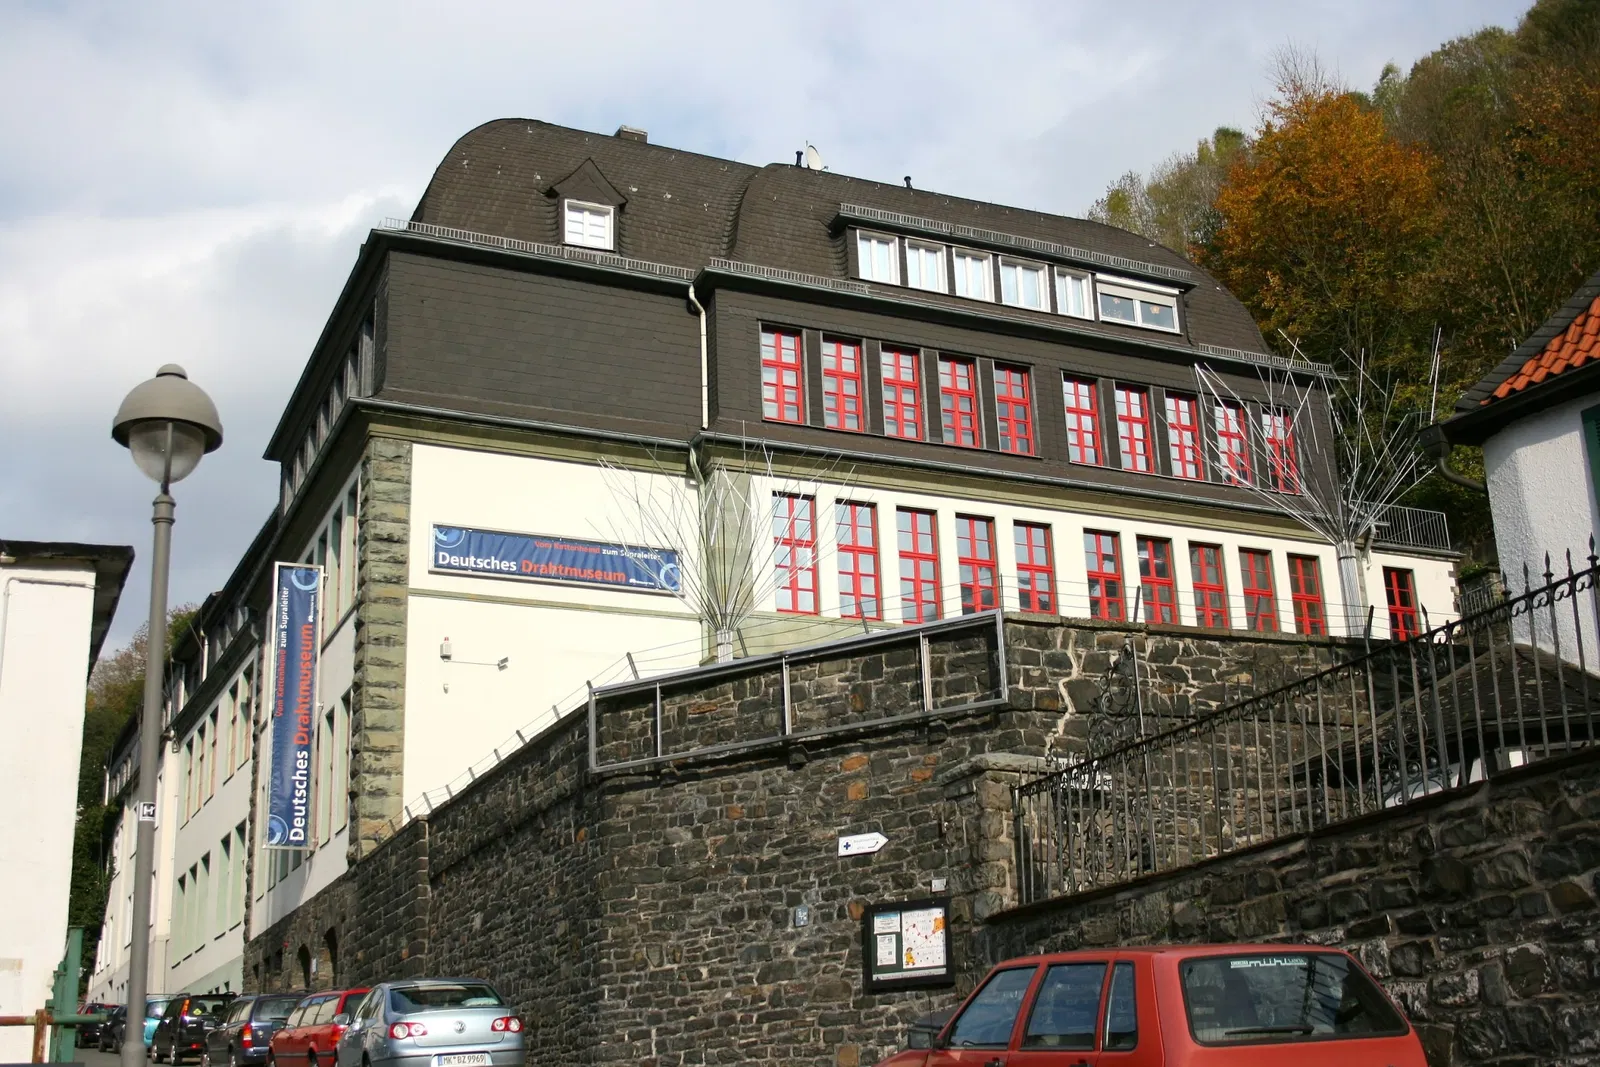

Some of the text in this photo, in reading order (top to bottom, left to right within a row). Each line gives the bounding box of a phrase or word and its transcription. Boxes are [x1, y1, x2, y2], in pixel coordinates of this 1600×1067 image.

[534, 541, 552, 549] Vom
[553, 542, 600, 553] Kettenhemd
[438, 551, 626, 583] Deutsches Drahtmuseum
[280, 587, 290, 629] Supraleiter
[277, 649, 287, 698] Kettenhemd
[274, 699, 285, 717] Vom
[289, 624, 313, 841] Deutsches Drahtmuseum
[444, 1054, 485, 1064] MK BZ 9969
